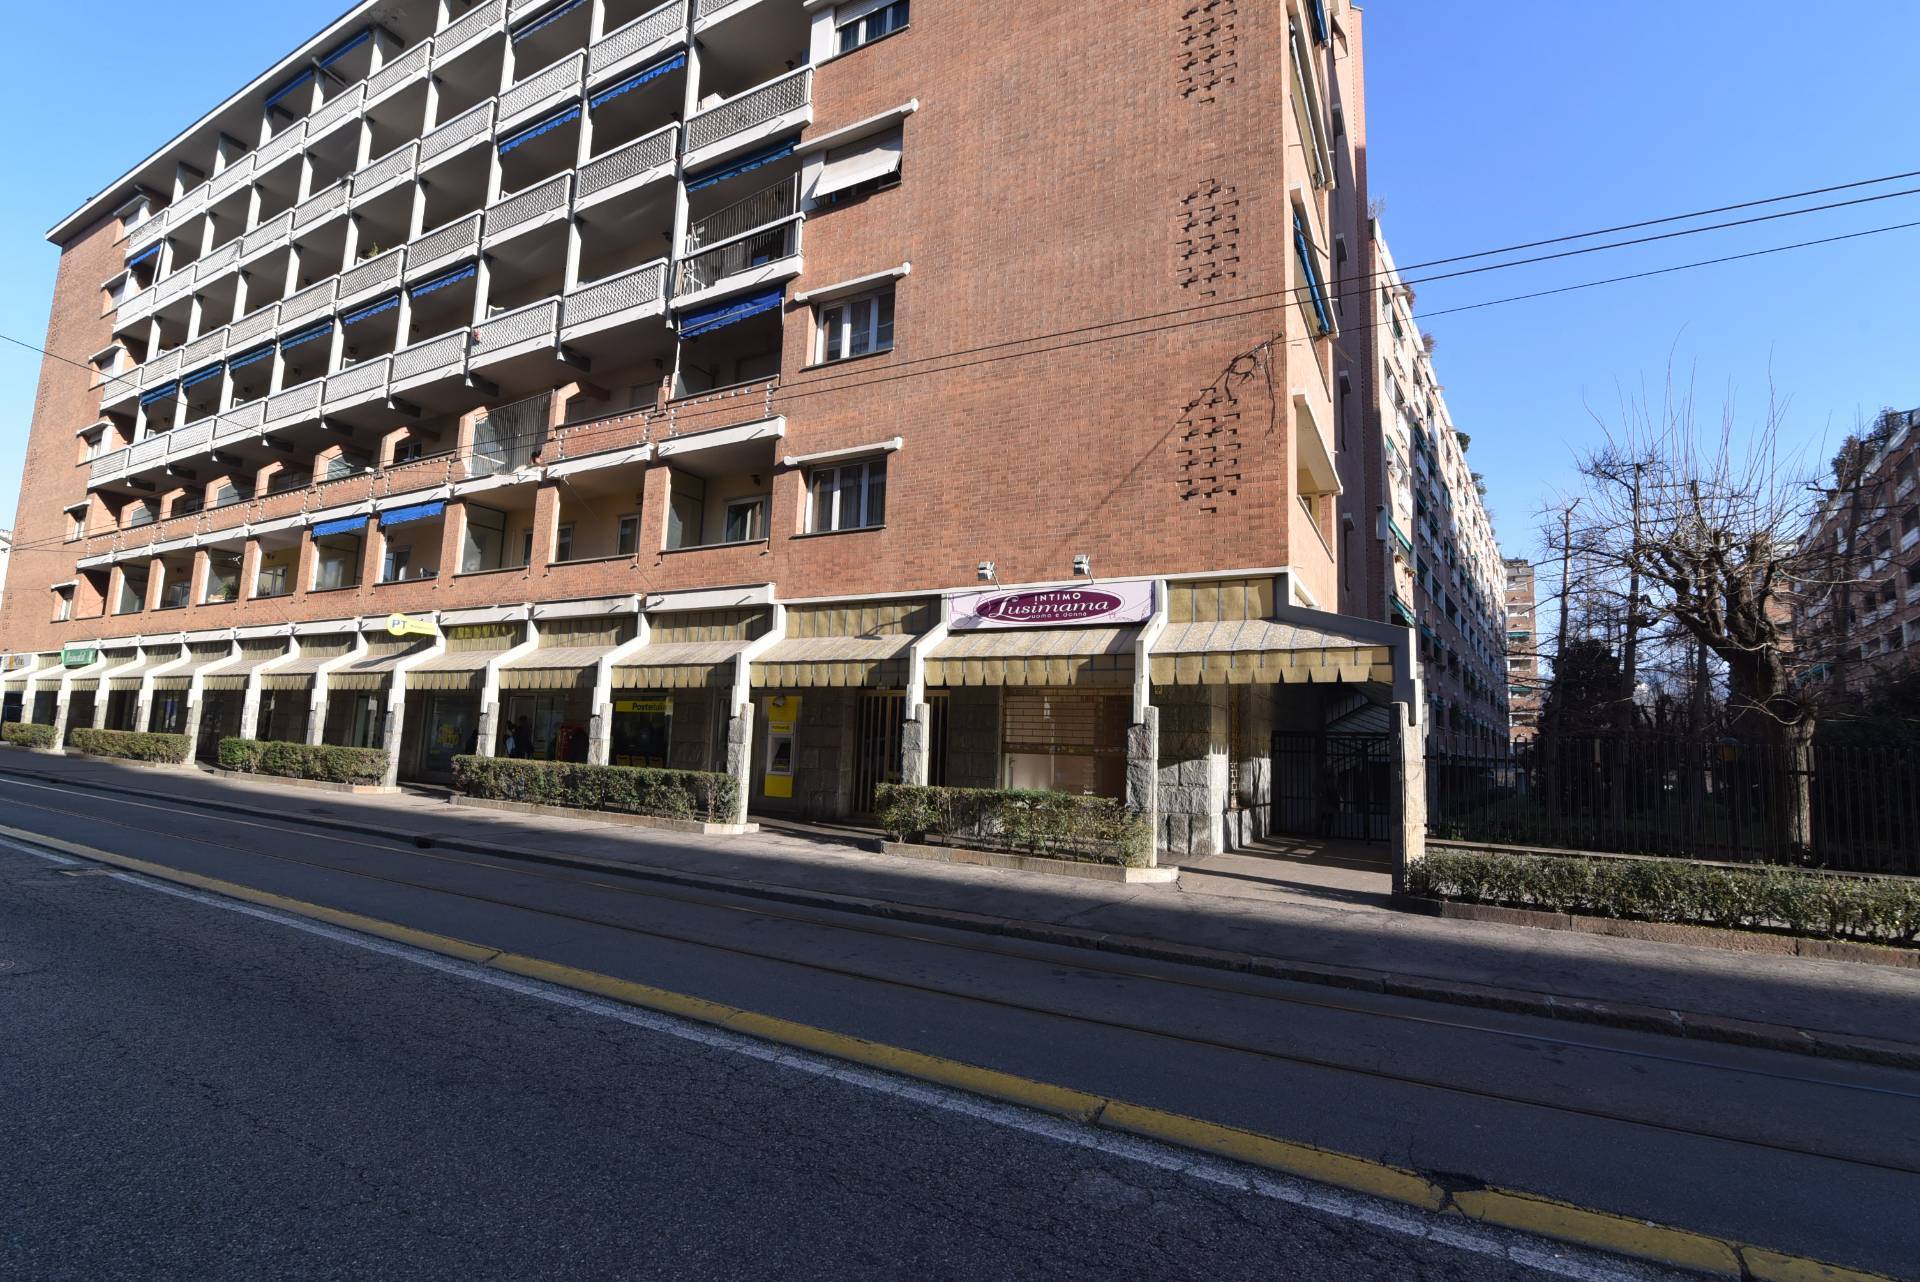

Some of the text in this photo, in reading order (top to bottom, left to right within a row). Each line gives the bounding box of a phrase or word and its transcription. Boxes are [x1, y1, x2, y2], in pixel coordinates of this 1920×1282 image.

[1034, 592, 1081, 602] INTIMO
[988, 595, 1109, 620] Lusimama
[391, 619, 408, 630] PT
